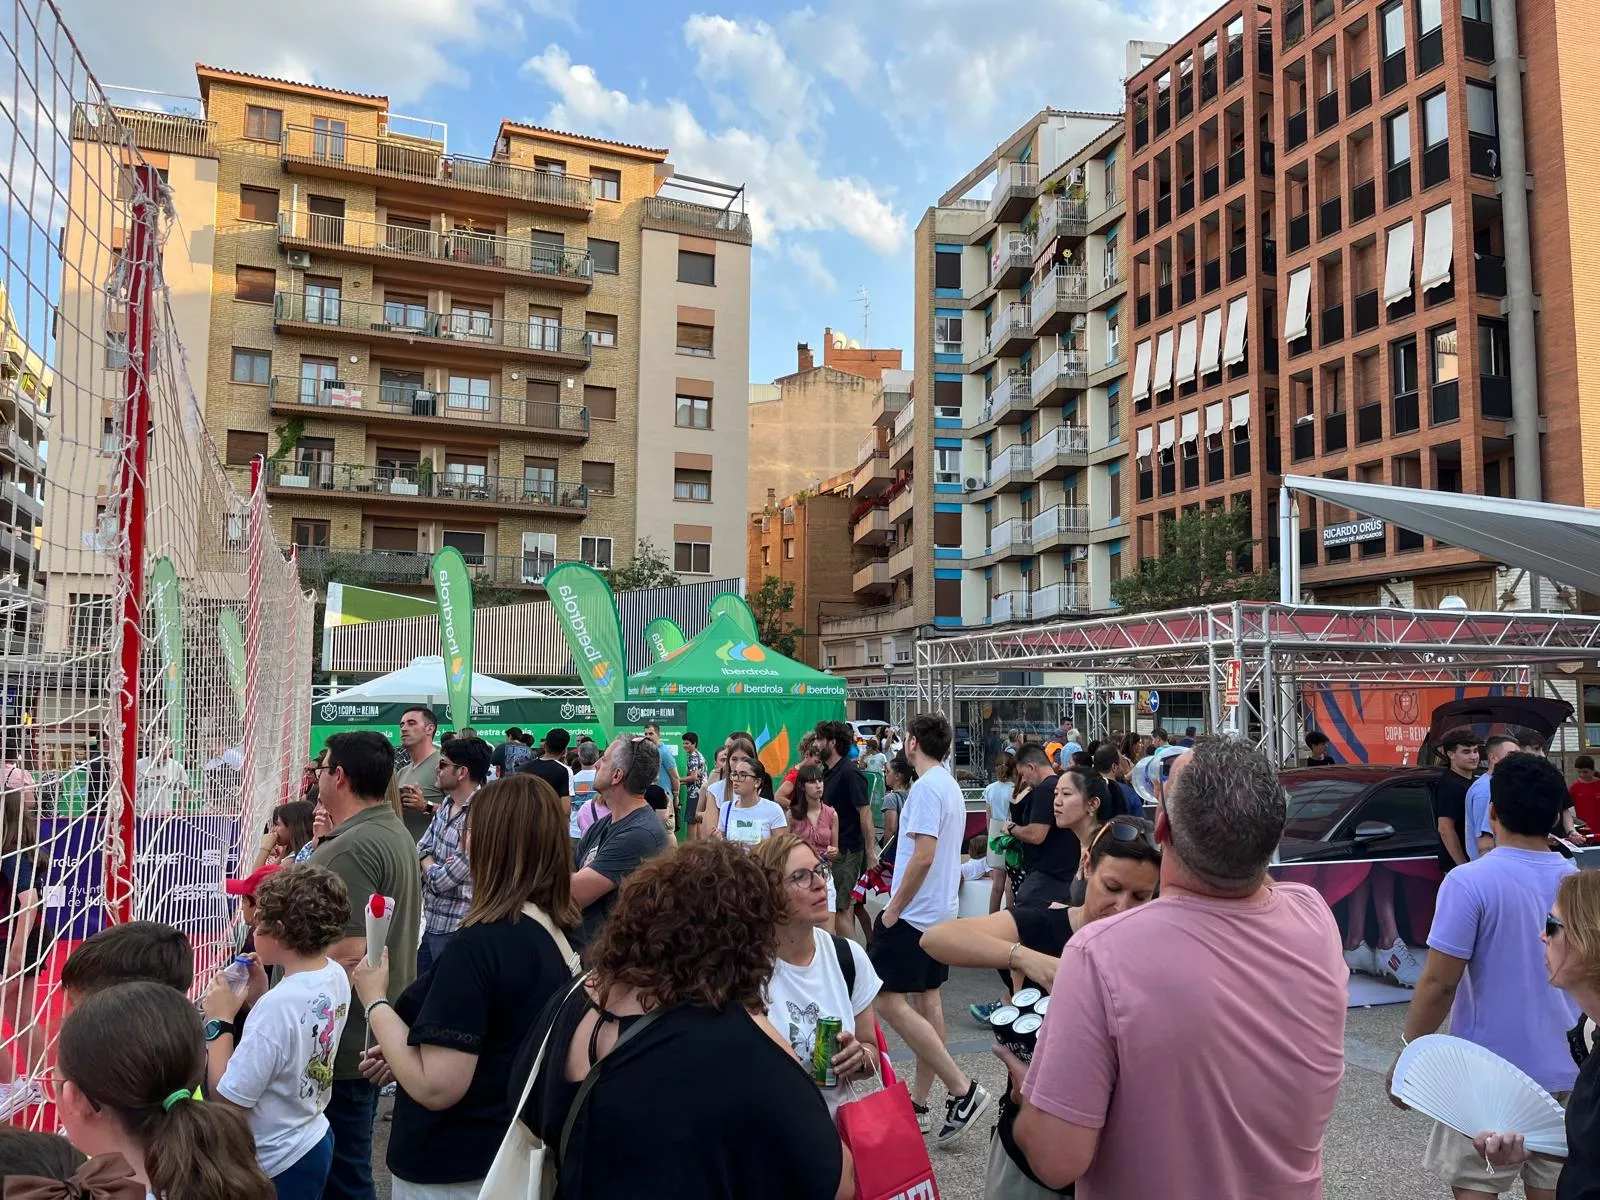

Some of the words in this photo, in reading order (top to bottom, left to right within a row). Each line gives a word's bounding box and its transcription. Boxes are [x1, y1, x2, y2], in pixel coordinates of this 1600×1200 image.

[1323, 525, 1358, 540] RICARDO
[1359, 518, 1382, 533] ORÚS
[1355, 531, 1383, 540] ABOGADOS
[721, 667, 779, 676] Iberdrola
[678, 683, 720, 694] Iberdrola
[743, 684, 783, 694] Iberdrola
[807, 684, 845, 695] Iberdrola
[341, 705, 356, 715] COPA
[361, 705, 379, 715] REINA
[483, 705, 500, 715] REINA
[578, 704, 591, 714] COPA
[1384, 726, 1403, 741] COPA
